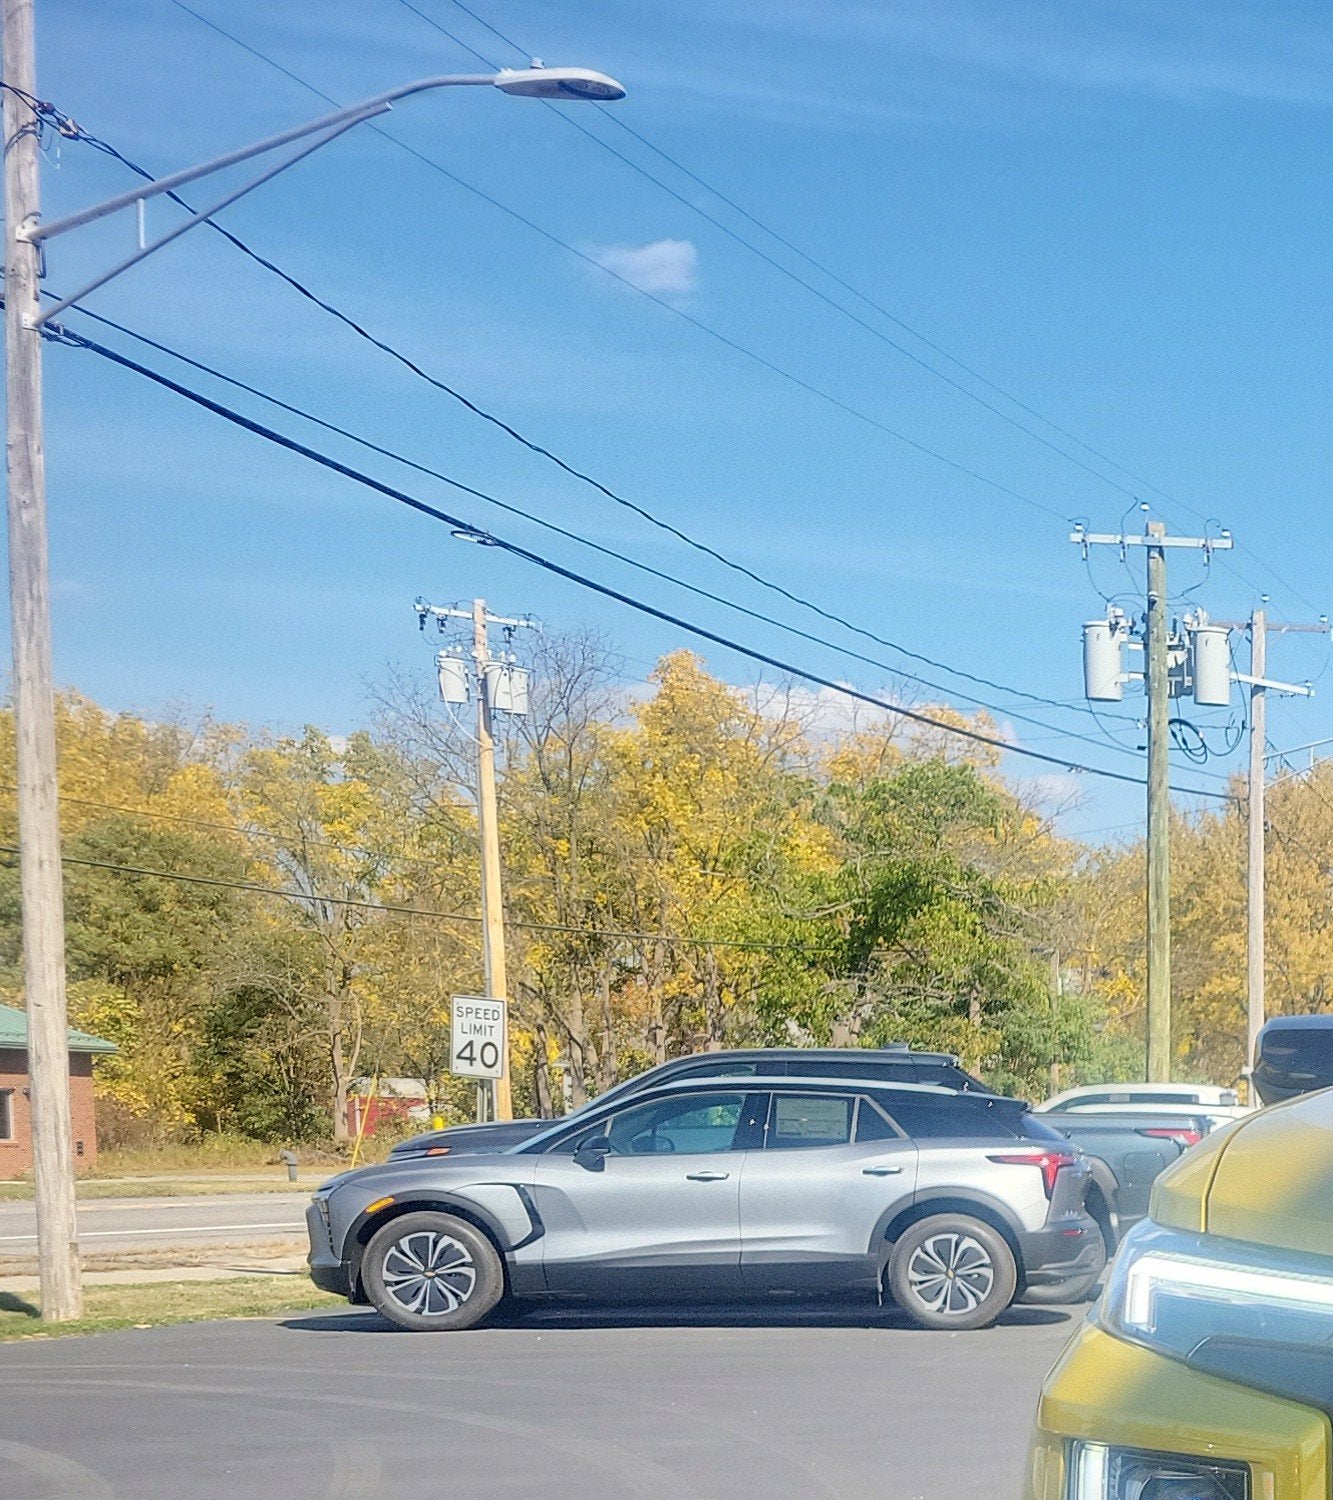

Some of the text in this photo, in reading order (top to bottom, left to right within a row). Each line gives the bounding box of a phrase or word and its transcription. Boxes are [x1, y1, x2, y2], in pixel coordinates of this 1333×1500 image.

[456, 1006, 500, 1021] SPEED
[461, 1023, 495, 1037] LIMIT
[456, 1040, 499, 1069] 40
